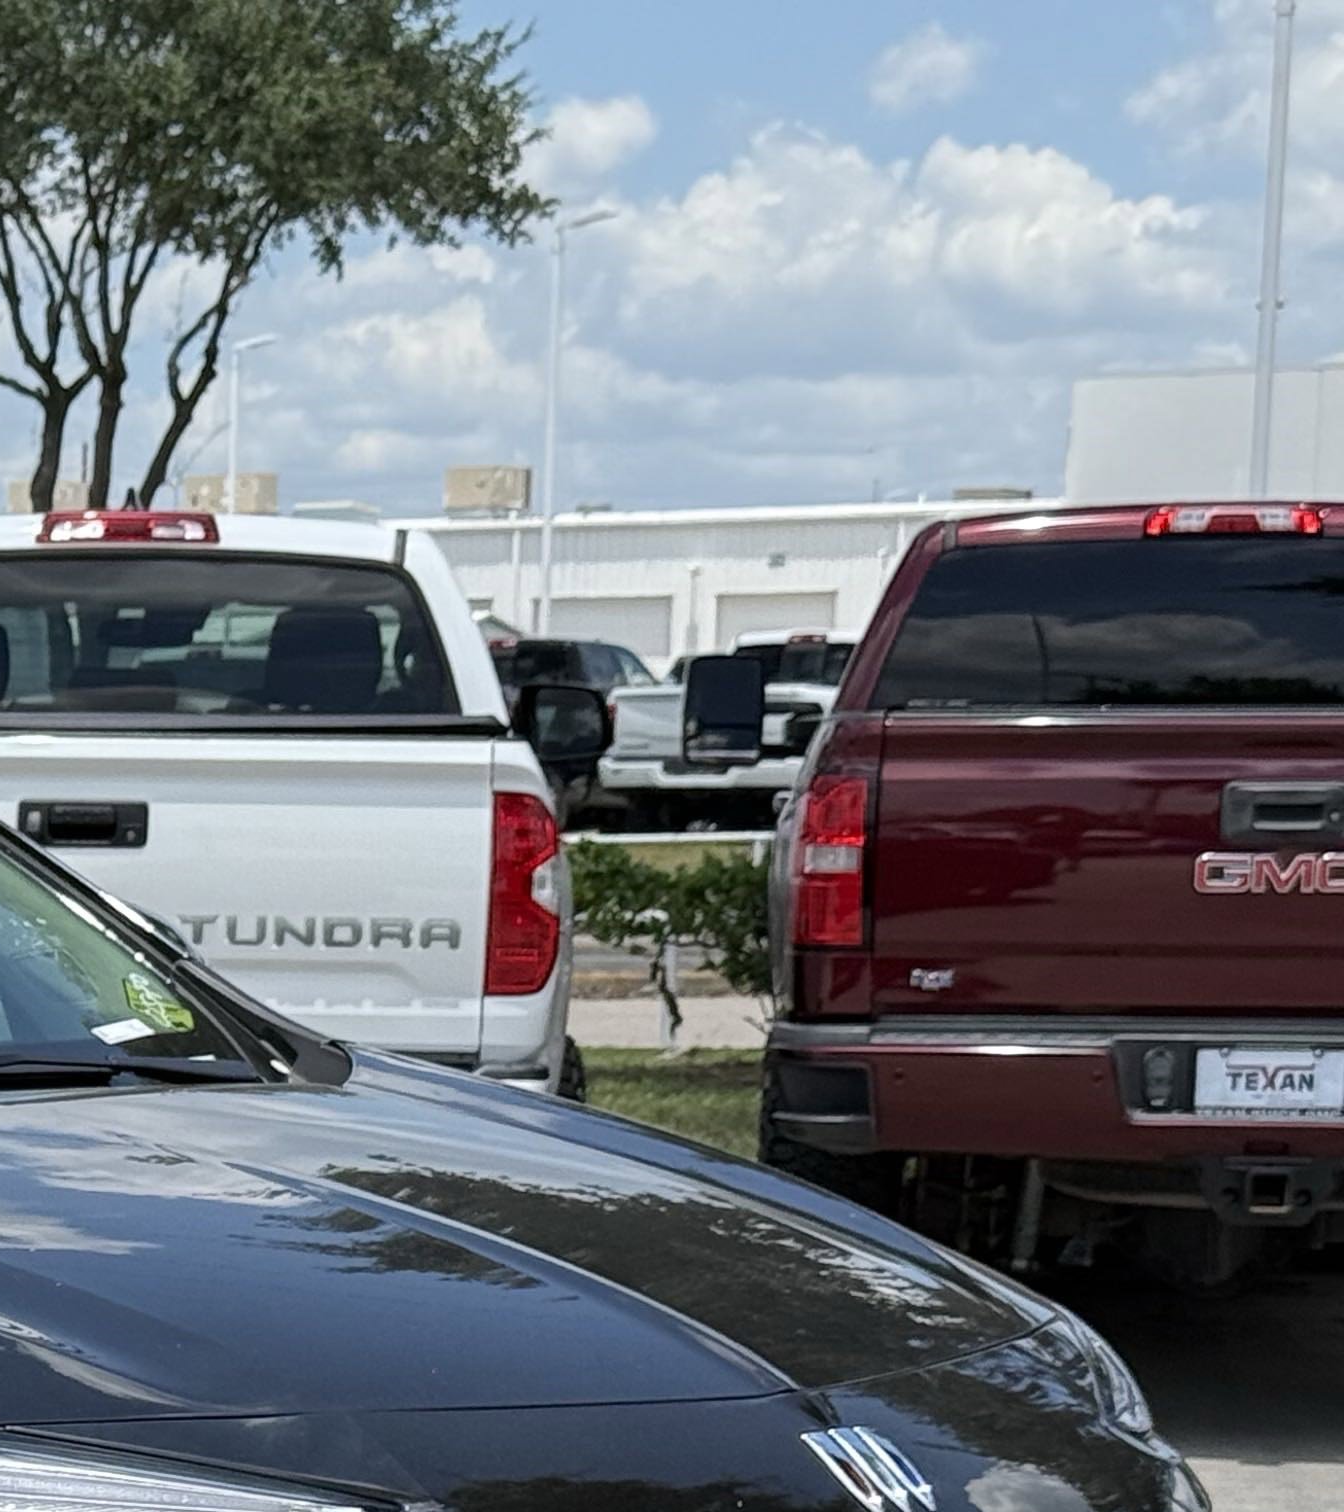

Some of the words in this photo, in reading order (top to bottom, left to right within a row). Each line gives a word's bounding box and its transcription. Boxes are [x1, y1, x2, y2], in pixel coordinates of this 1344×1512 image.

[1193, 851, 1344, 895] GMC
[177, 914, 462, 950] TUNDRA
[1224, 1065, 1315, 1092] TEXAN
